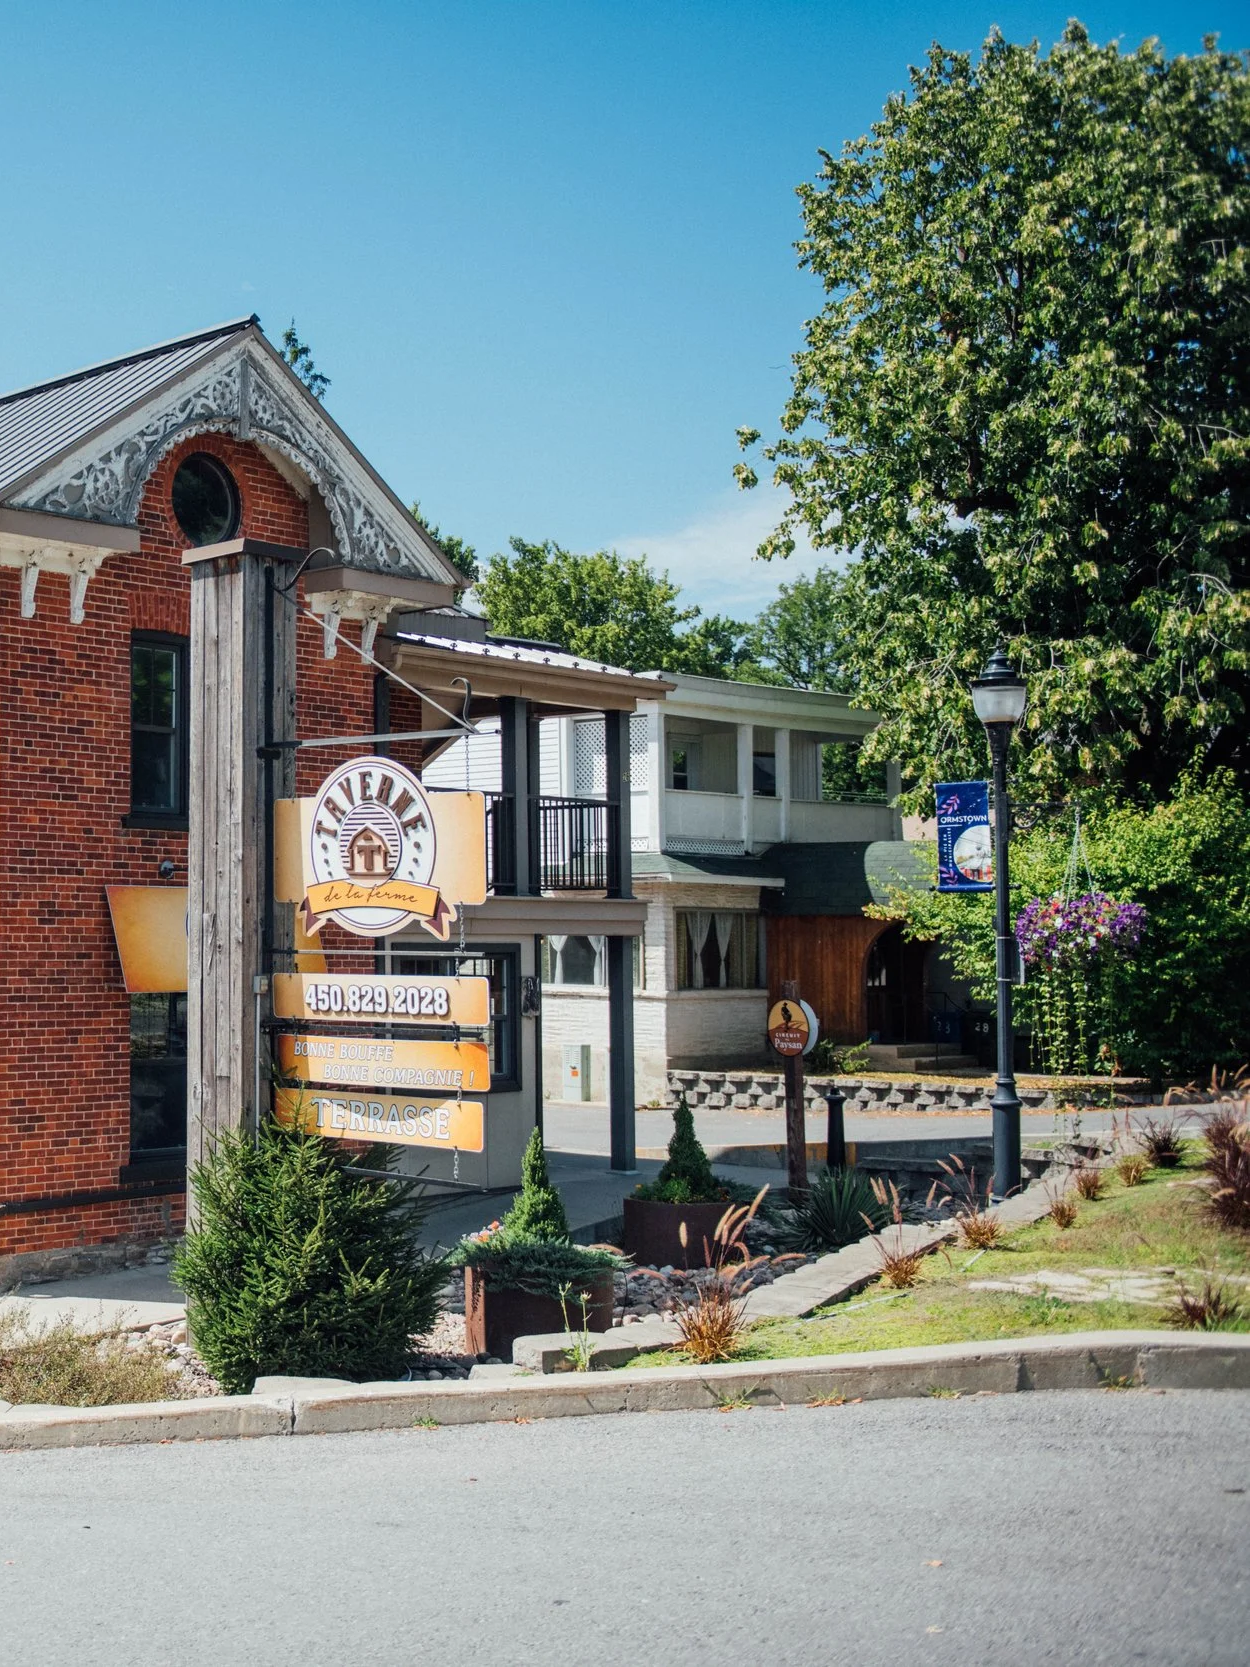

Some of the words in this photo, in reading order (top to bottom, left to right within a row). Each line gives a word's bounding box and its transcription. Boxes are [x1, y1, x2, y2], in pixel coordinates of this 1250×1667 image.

[315, 770, 427, 838] TAVERNE
[940, 815, 987, 824] ORMSTOWN
[324, 885, 342, 903] de
[347, 883, 363, 899] la
[366, 883, 419, 903] ferme
[305, 984, 450, 1017] 450.829.2028
[293, 1041, 336, 1059] BONNE
[339, 1043, 394, 1062] BOUFFE
[774, 1038, 803, 1051] Paysan
[323, 1064, 369, 1082] BONNE
[373, 1066, 463, 1087] COMPAGNIE
[468, 1071, 475, 1087] !
[311, 1097, 451, 1140] TERRASSE
